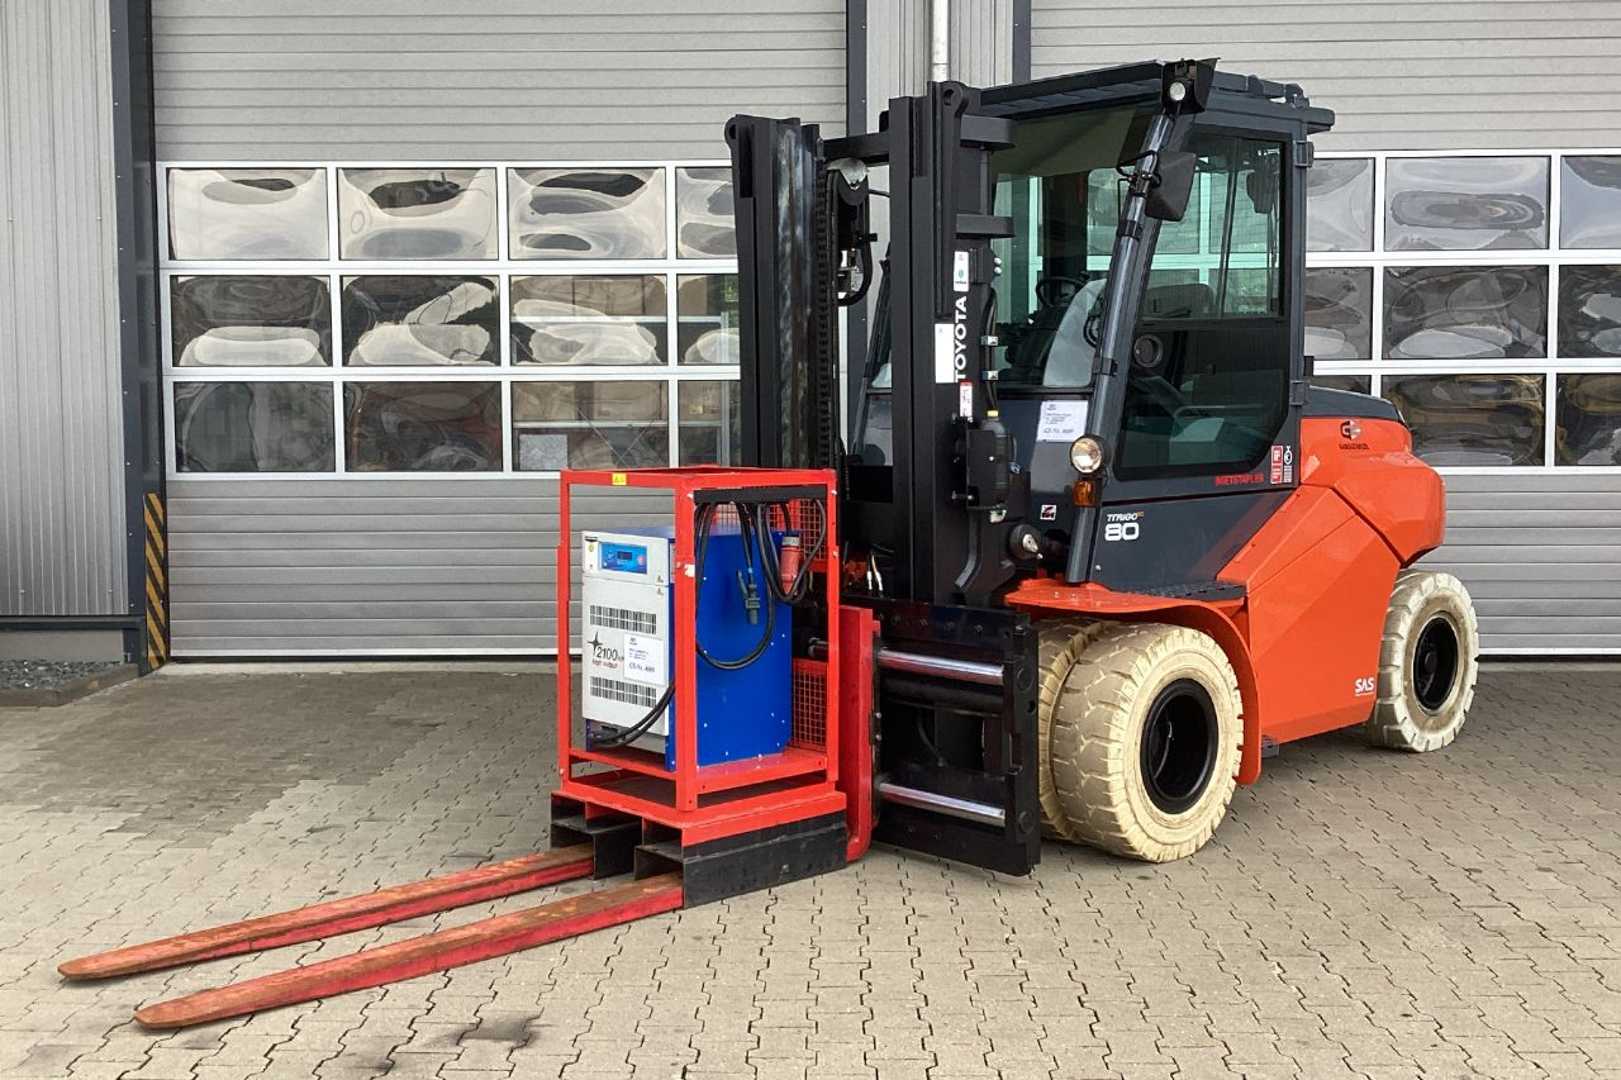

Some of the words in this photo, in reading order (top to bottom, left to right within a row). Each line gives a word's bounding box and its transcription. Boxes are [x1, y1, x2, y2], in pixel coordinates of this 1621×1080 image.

[954, 296, 967, 383] TOYOTA
[1105, 522, 1140, 541] 80
[597, 646, 618, 661] 2100
[1355, 677, 1374, 693] SAS
